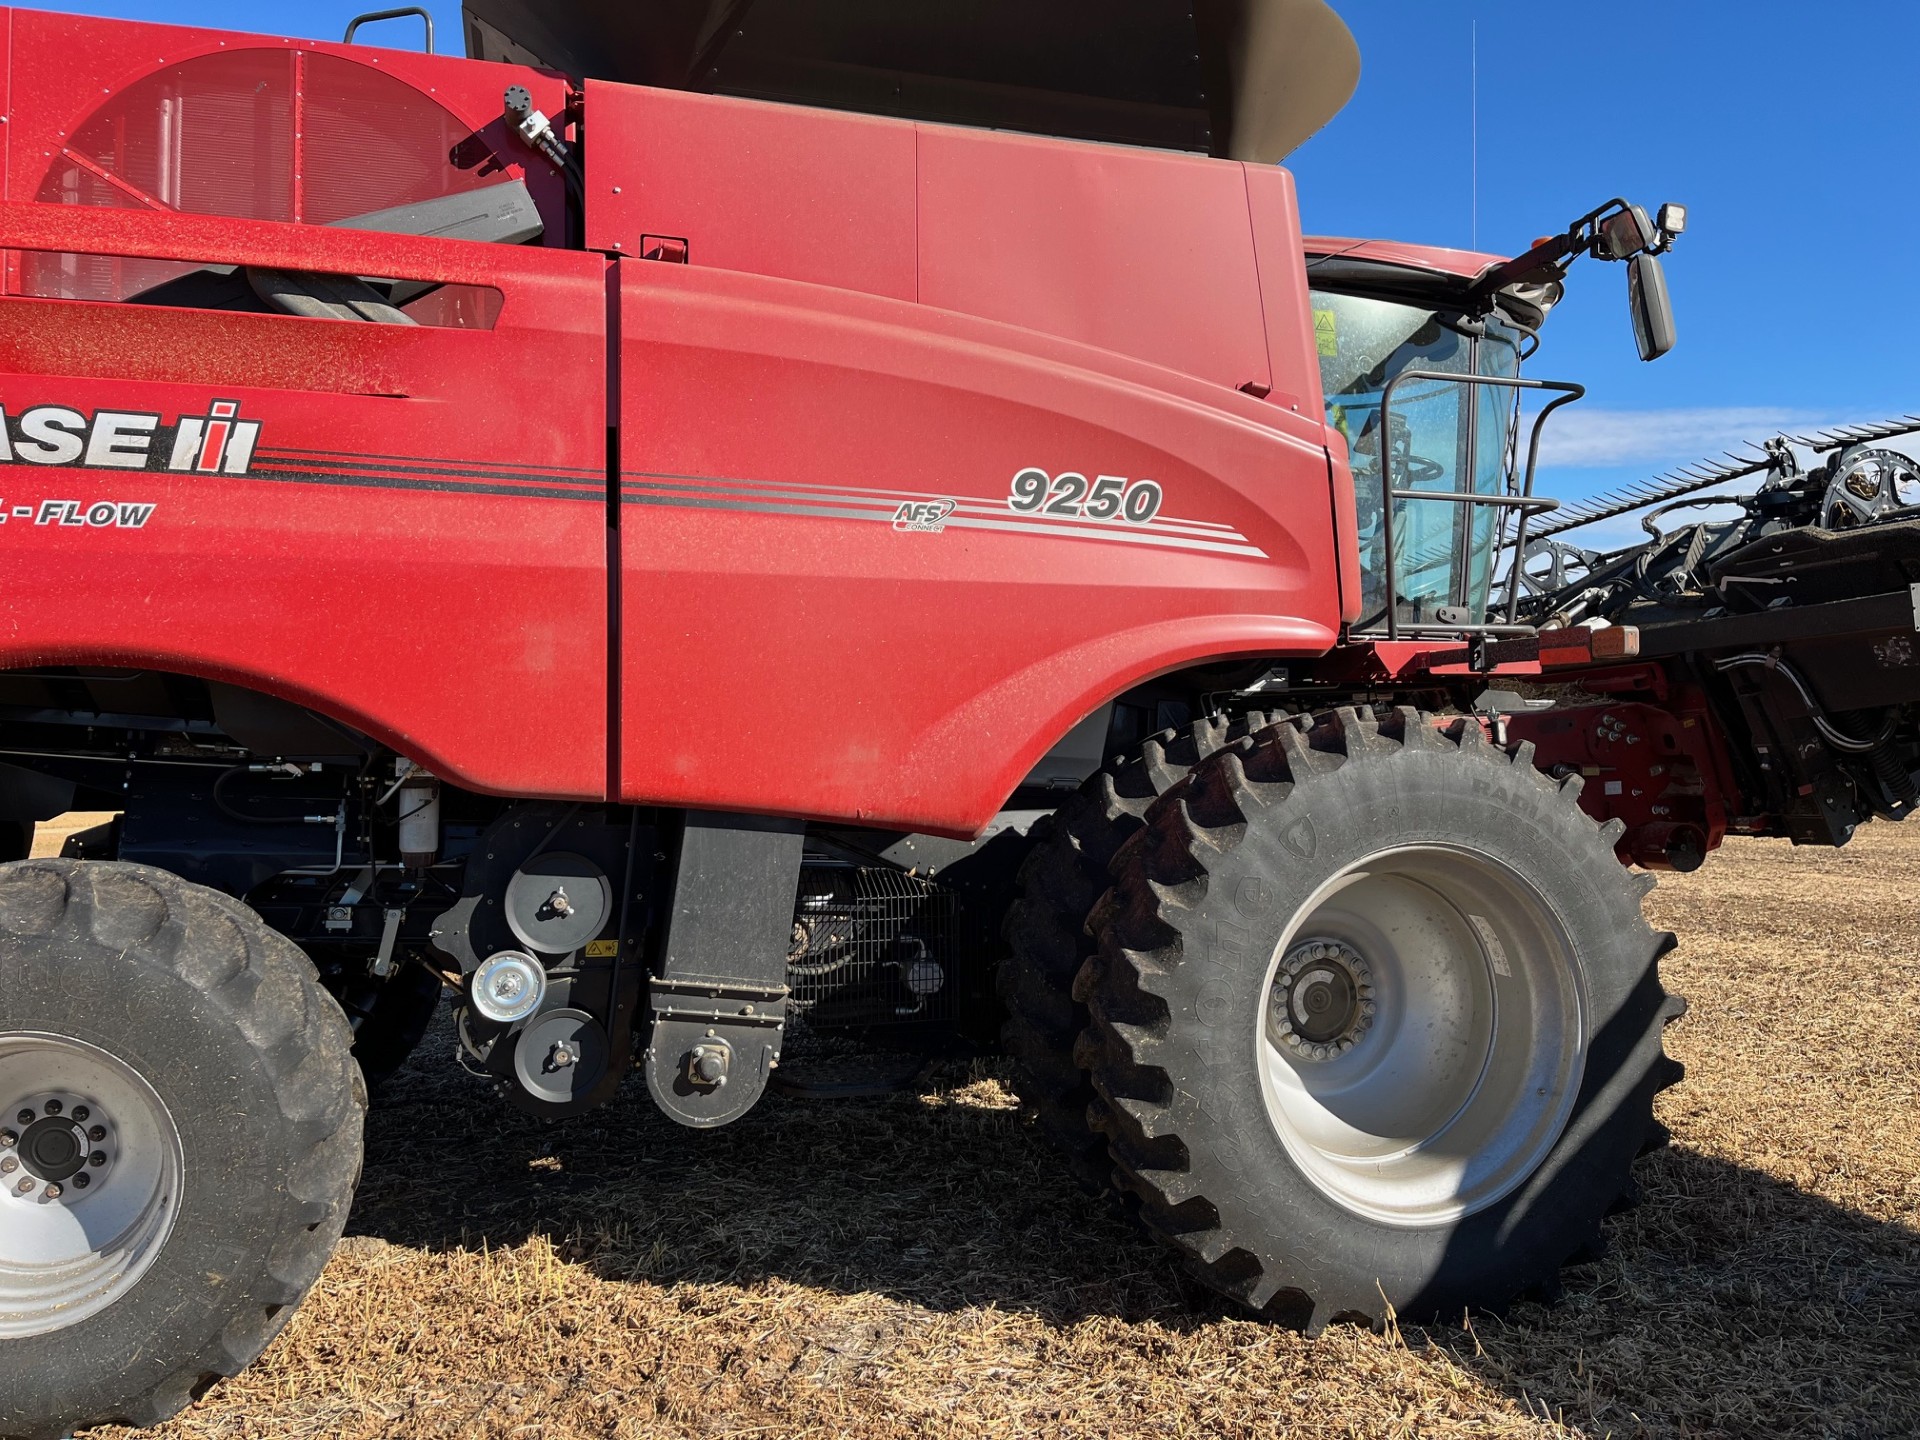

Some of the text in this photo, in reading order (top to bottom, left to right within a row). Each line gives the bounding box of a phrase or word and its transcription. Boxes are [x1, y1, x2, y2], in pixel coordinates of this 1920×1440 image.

[0, 404, 160, 468] SE
[892, 501, 944, 523] AFS
[1007, 467, 1163, 525] 9250
